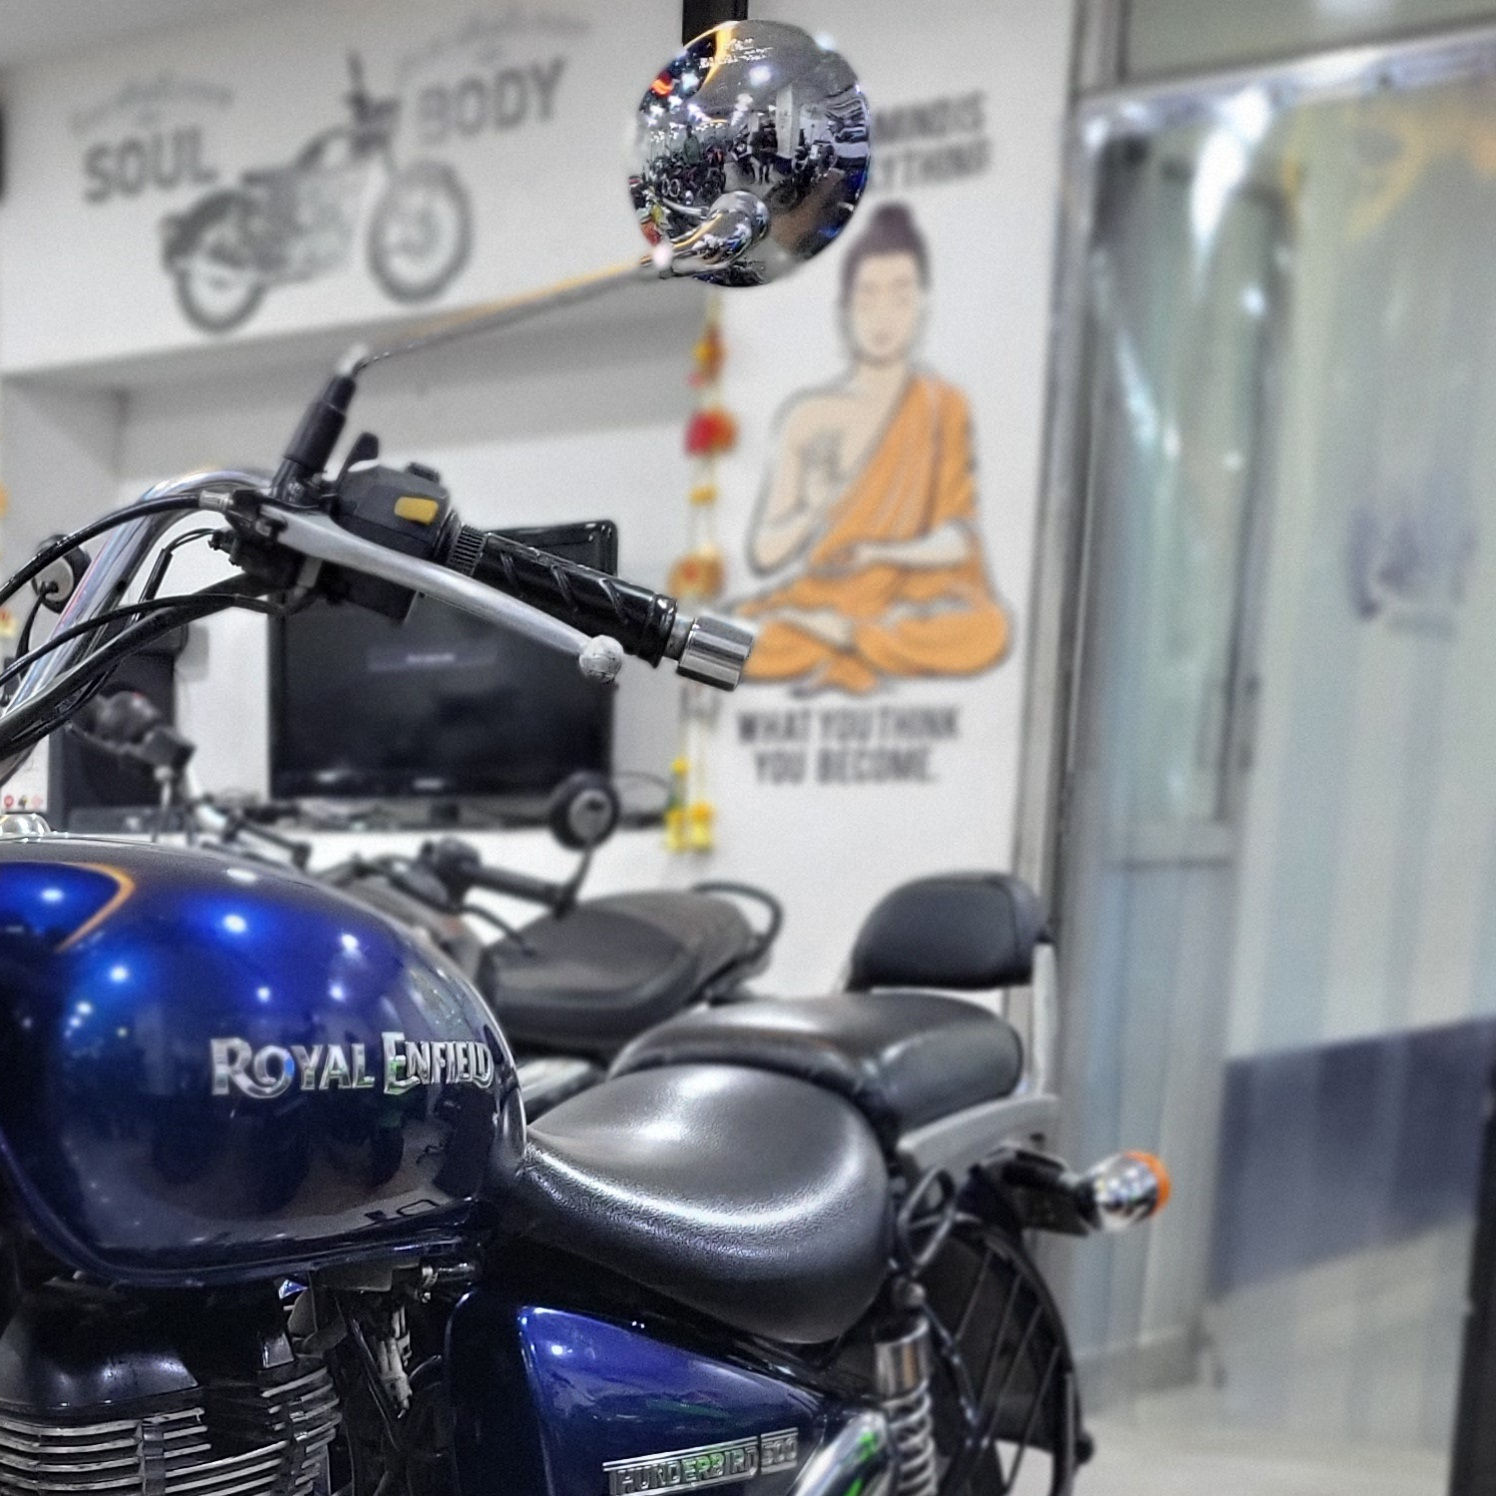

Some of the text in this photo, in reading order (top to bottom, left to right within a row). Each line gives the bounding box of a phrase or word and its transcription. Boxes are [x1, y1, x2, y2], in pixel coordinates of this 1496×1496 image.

[415, 56, 566, 144] BODY
[83, 124, 219, 204] SOUL
[738, 708, 810, 745] WHAT
[819, 708, 874, 742] YOU
[756, 751, 805, 784] YOU
[210, 1031, 495, 1099] ROYAL ENFIELD
